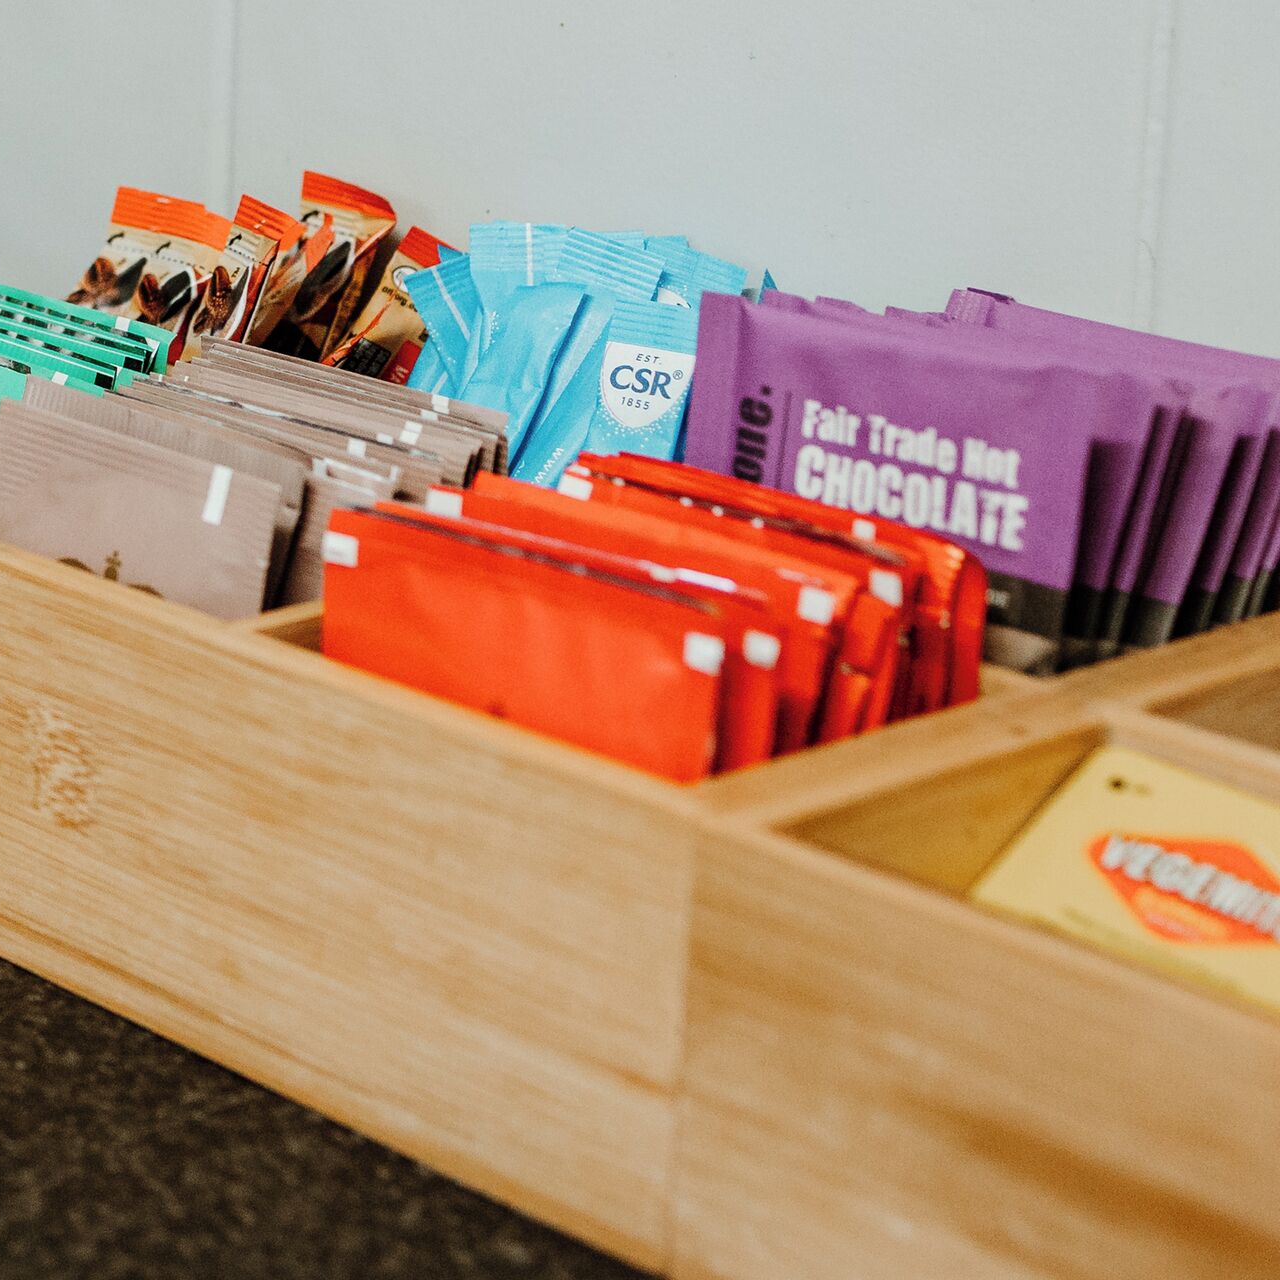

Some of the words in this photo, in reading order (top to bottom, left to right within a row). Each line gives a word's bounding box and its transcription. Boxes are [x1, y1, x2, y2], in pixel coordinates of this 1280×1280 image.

[636, 353, 662, 365] EST.
[621, 396, 650, 410] 1855
[801, 399, 861, 448] Fair
[868, 415, 957, 474] Trade
[963, 437, 1021, 489] Hot
[794, 444, 1029, 552] CHOCOLATE
